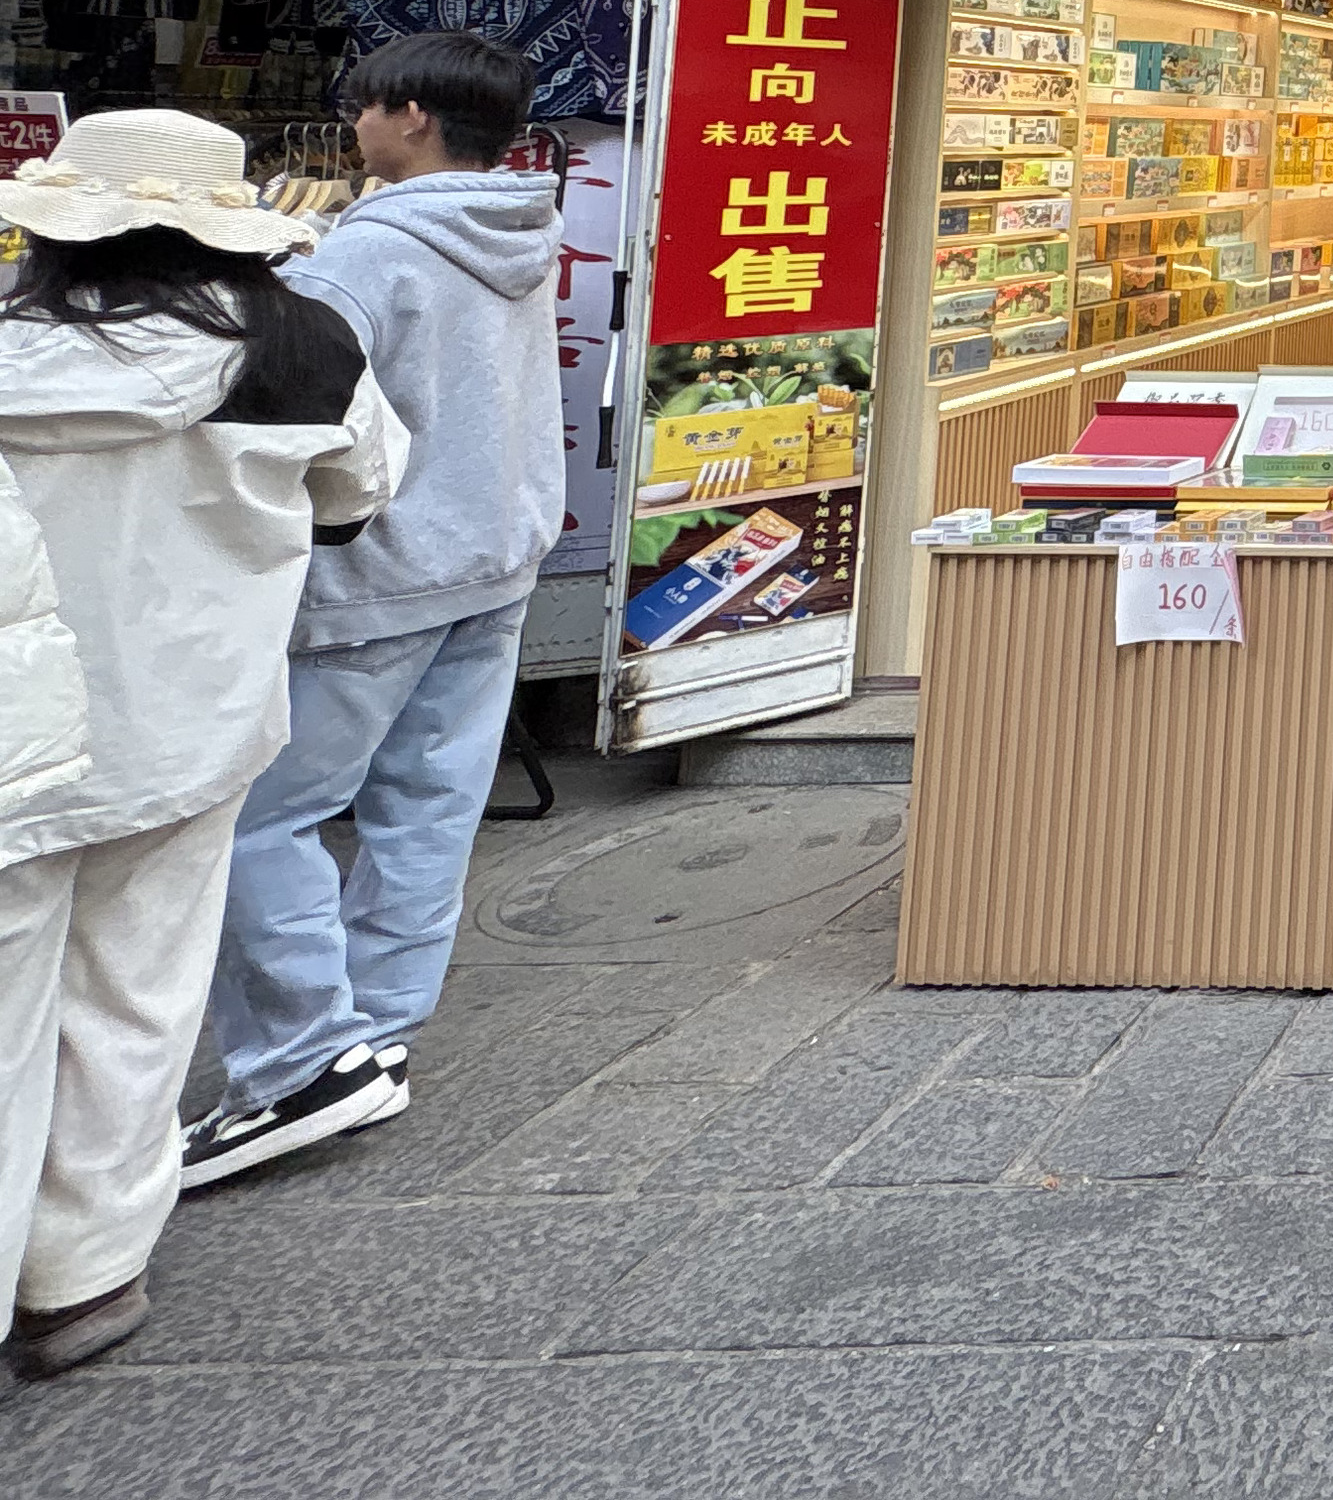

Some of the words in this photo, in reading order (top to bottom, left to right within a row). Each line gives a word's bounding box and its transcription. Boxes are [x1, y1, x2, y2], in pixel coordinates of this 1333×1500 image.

[701, 120, 853, 148] 未成年人
[709, 170, 830, 319] 出售
[692, 335, 836, 361] 精选优质原料
